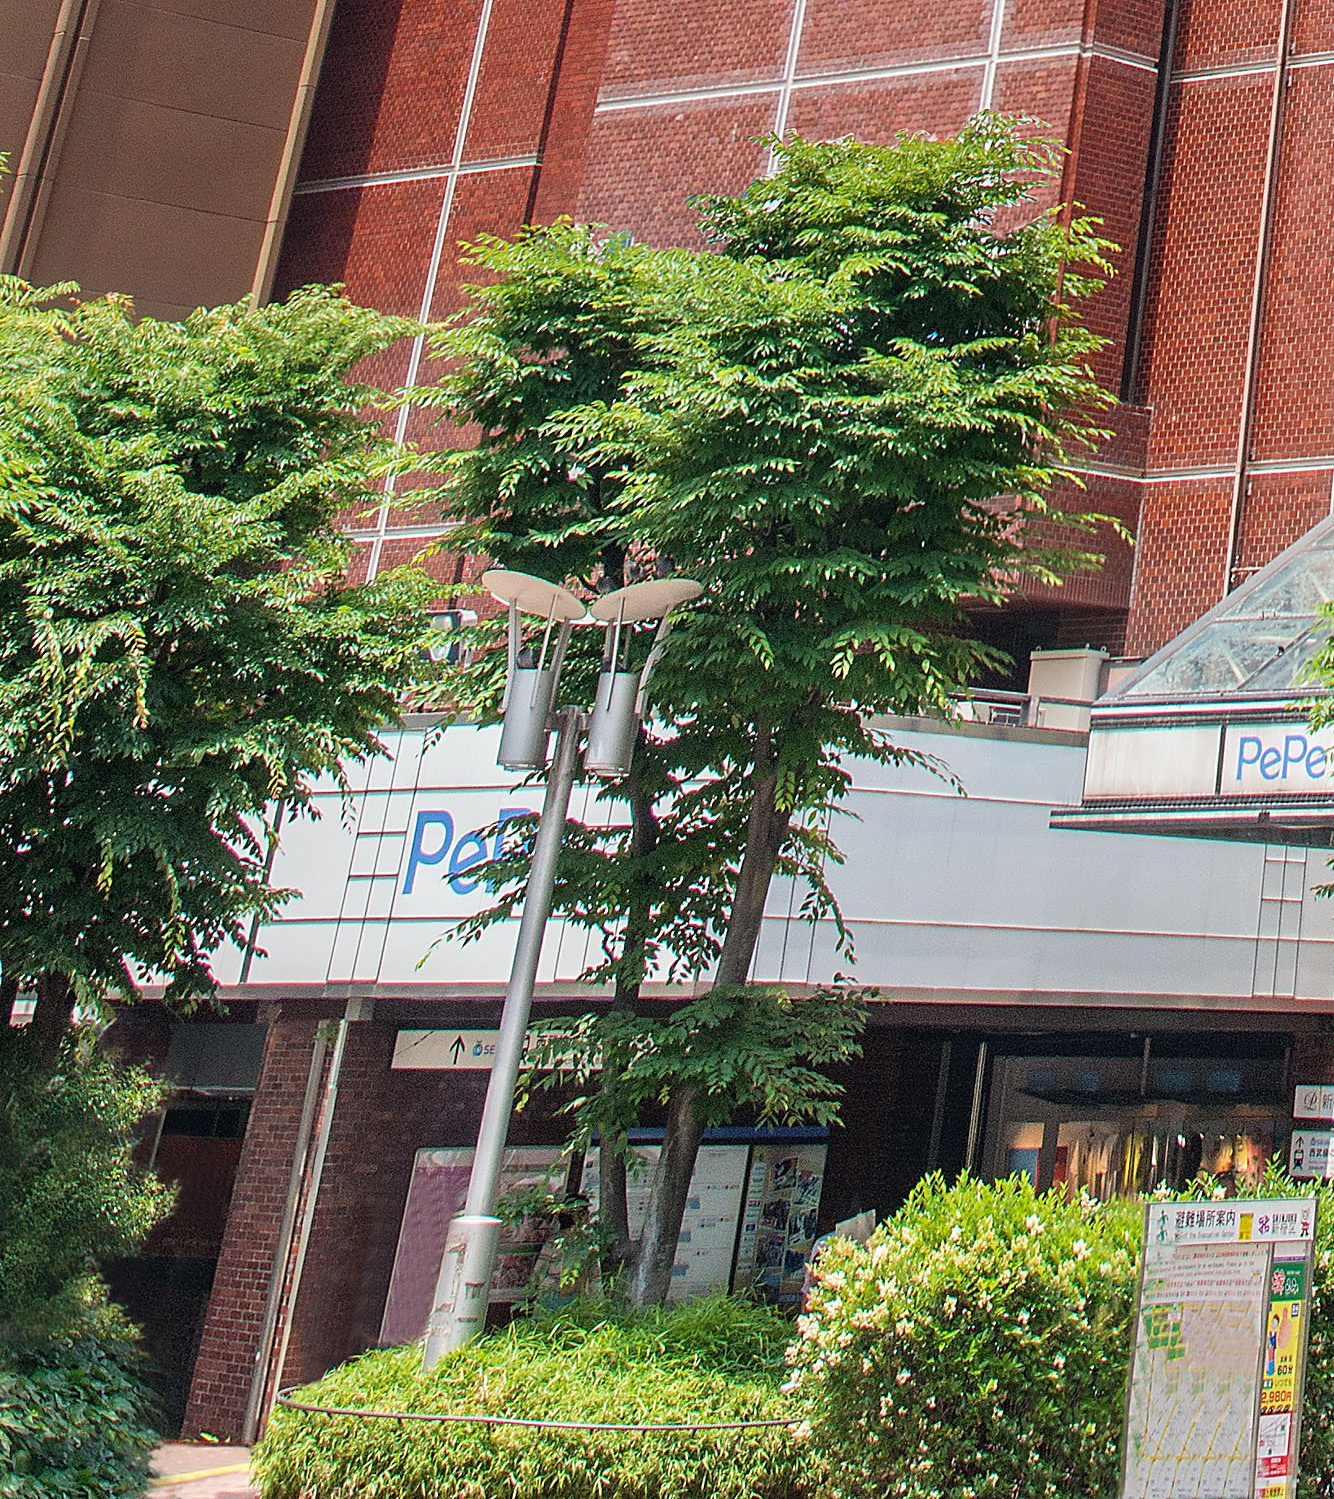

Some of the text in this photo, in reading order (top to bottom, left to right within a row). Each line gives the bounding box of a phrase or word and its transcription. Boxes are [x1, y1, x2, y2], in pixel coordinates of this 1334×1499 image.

[1236, 735, 1327, 780] PePe
[1175, 1210, 1236, 1229] 避難場所案内
